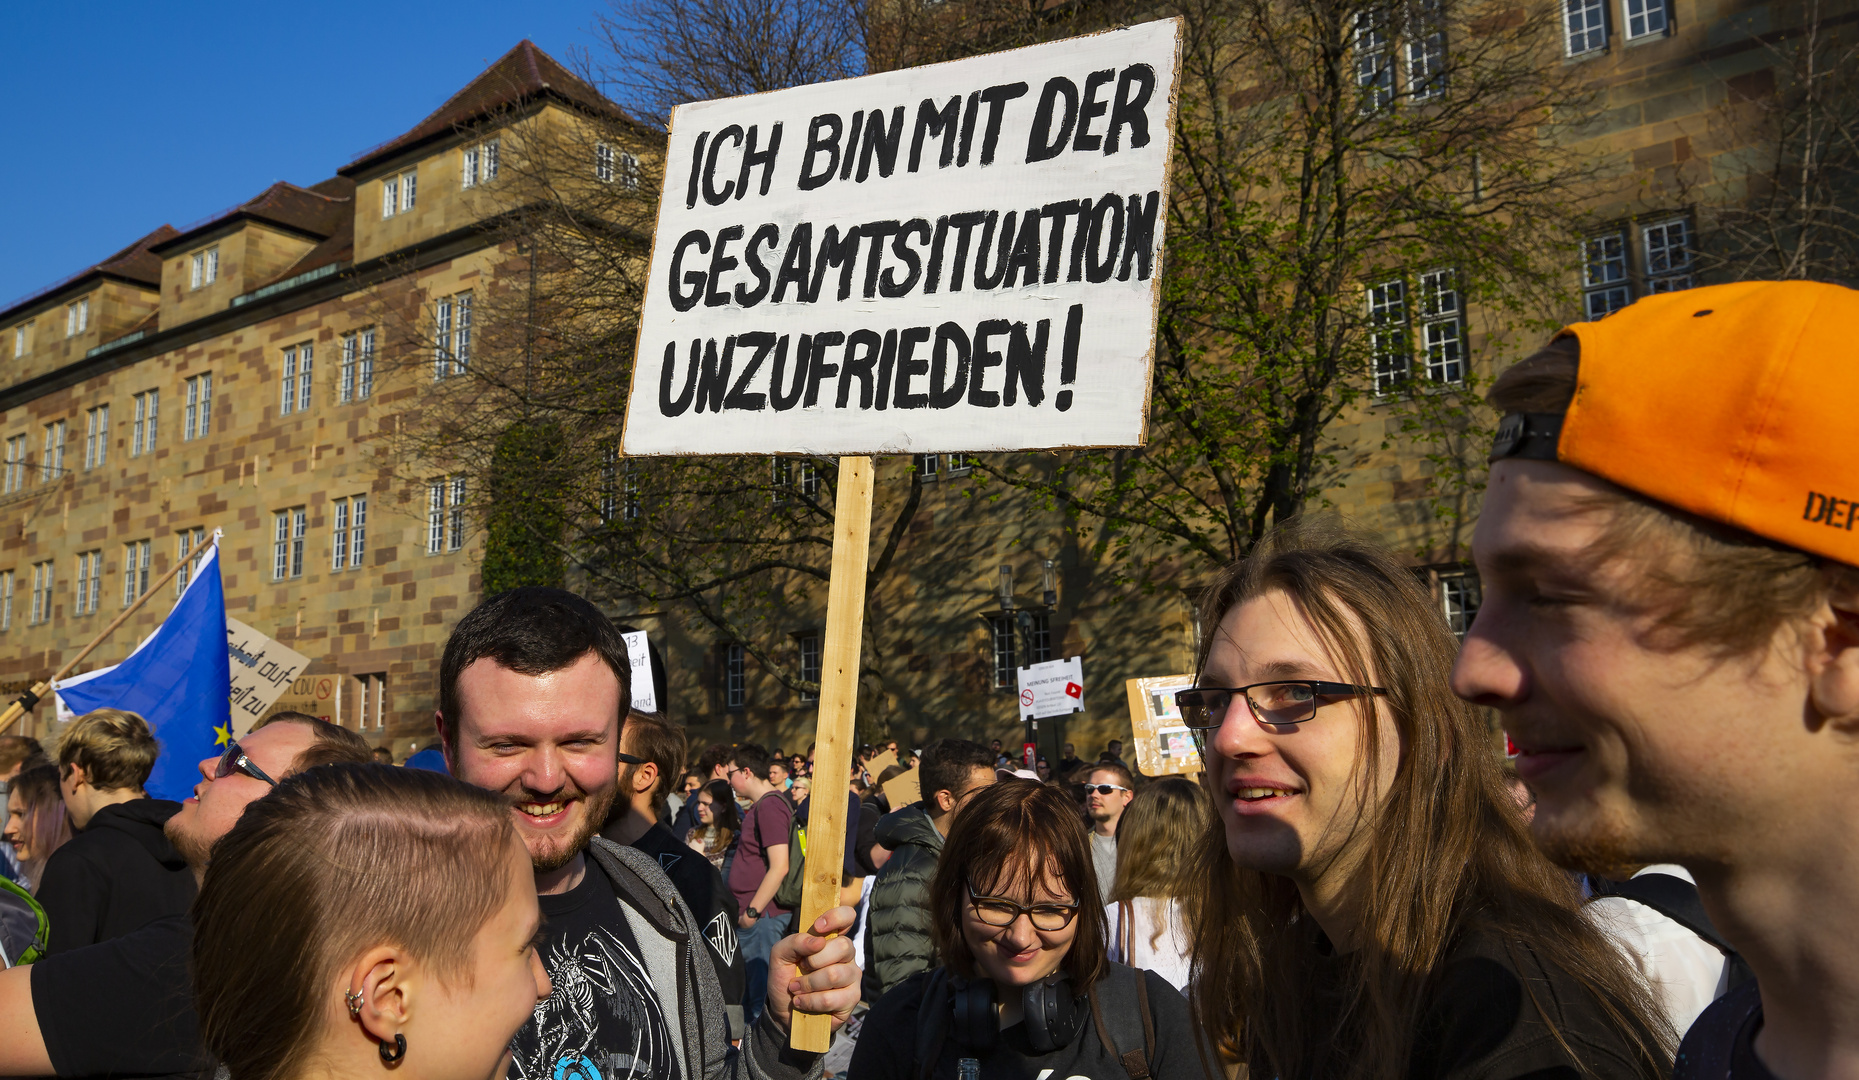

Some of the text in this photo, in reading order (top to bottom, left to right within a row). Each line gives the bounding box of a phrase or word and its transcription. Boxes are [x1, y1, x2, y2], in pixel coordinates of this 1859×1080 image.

[686, 63, 1158, 209] ICH BIN MIT DER
[668, 190, 1160, 312] GESAMTSITUATION
[658, 304, 1083, 417] UNZUFRIEDEN!
[629, 653, 646, 667] eit
[293, 677, 316, 695] CDU
[242, 696, 267, 716] zu
[632, 693, 652, 709] and
